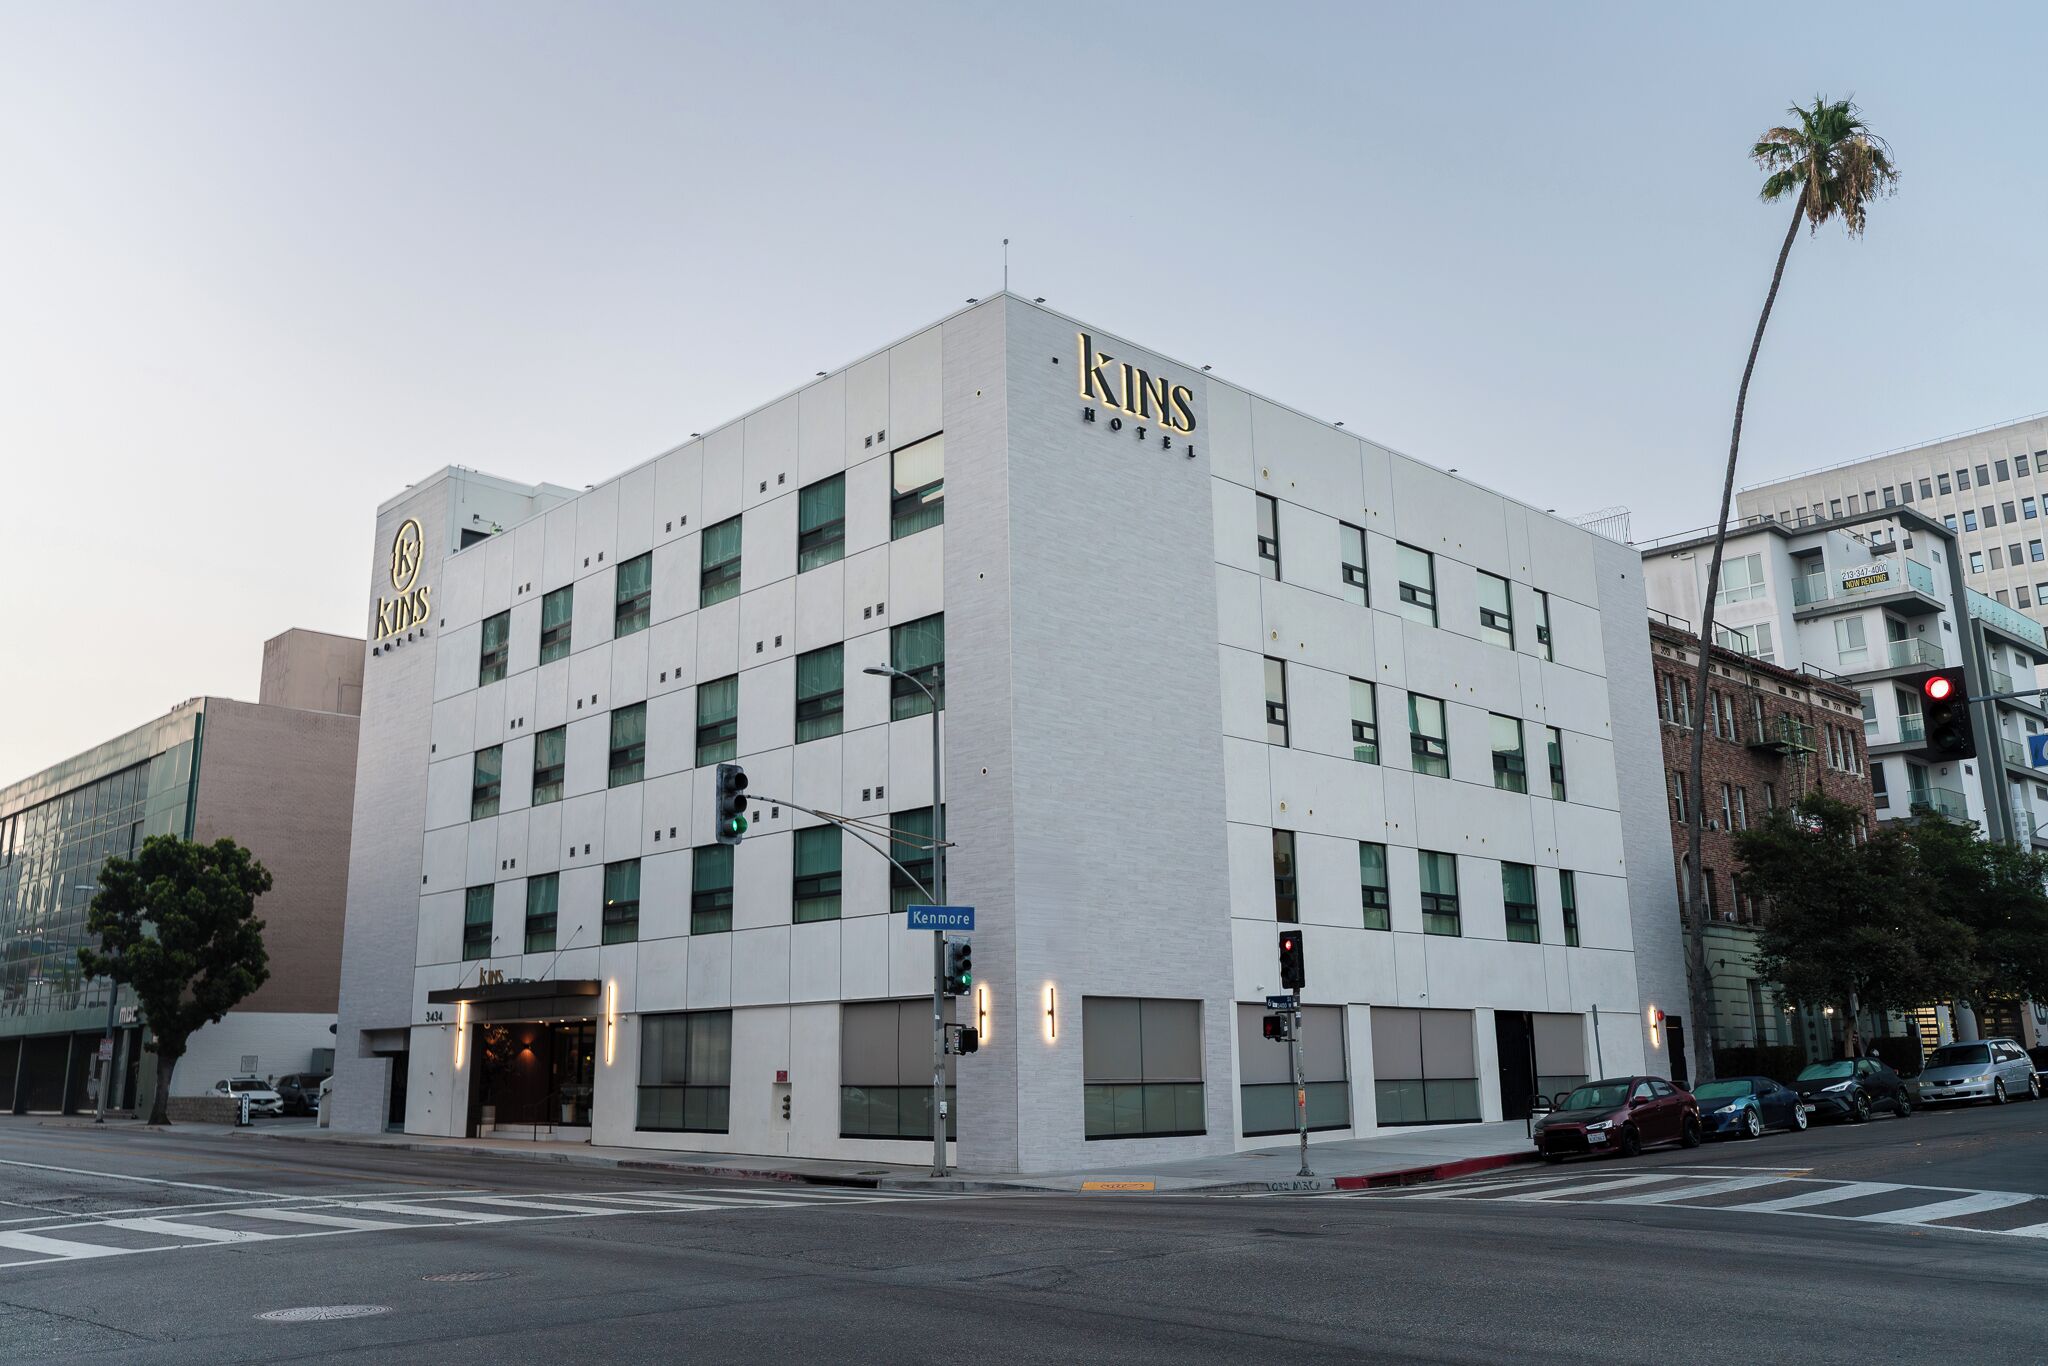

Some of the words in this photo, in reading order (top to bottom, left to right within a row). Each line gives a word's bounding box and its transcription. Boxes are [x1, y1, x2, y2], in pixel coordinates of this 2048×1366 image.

[1079, 333, 1197, 434] KINS
[1084, 407, 1196, 458] HOTEL
[1841, 564, 1888, 580] 213-347-4000
[1846, 578, 1860, 589] NOW
[1861, 574, 1887, 586] RENTING
[374, 586, 429, 641] KINS
[373, 628, 425, 657] HOTEL
[913, 910, 970, 925] Kenmore
[425, 1010, 443, 1022] 3434
